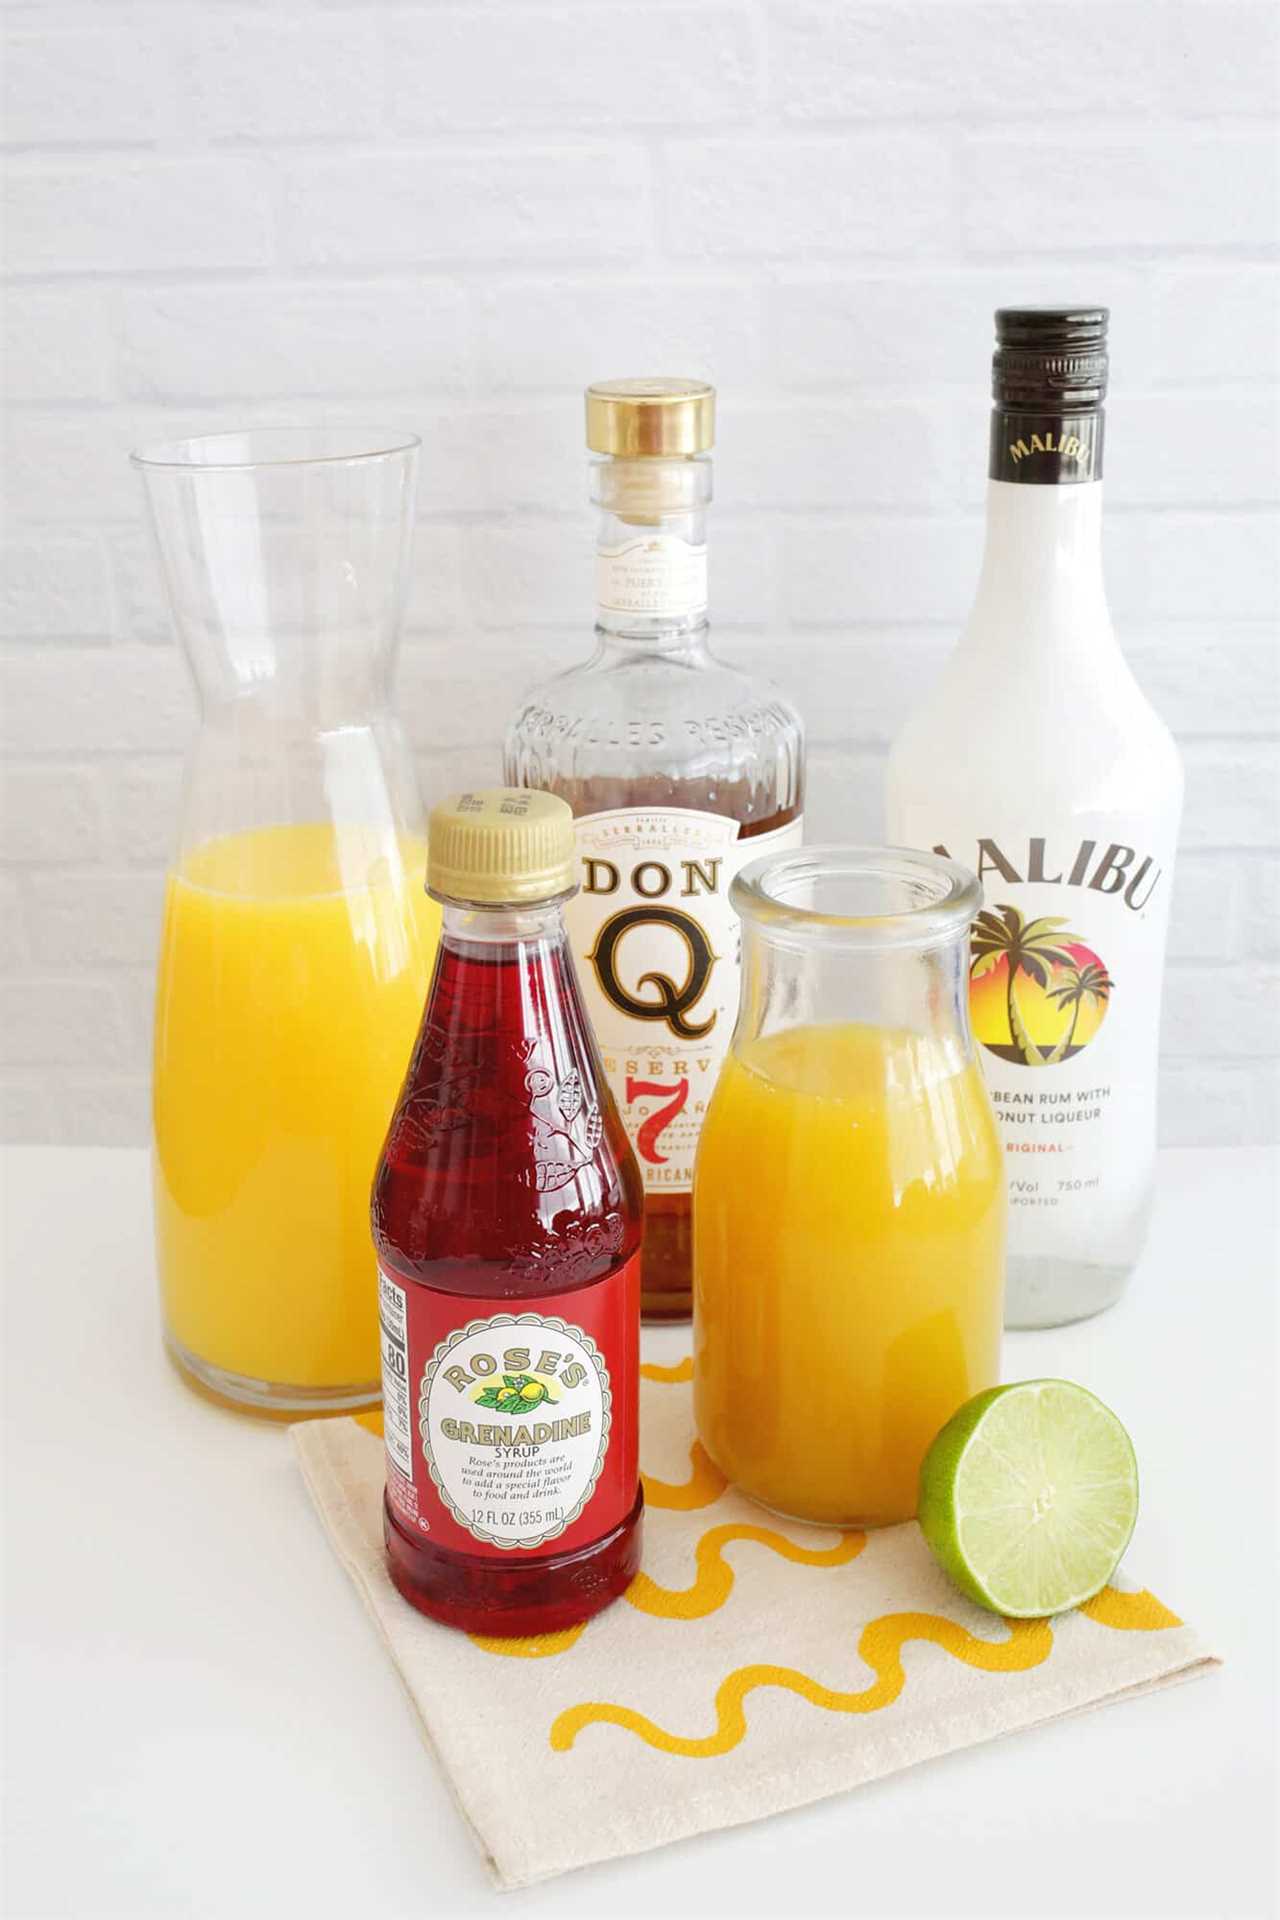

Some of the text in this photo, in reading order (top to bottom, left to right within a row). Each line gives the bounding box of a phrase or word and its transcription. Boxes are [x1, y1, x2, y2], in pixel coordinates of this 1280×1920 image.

[1009, 433, 1090, 464] MALIBU
[582, 856, 723, 899] DON
[584, 904, 721, 1040] Q
[604, 1057, 711, 1075] ESERV
[991, 1087, 1110, 1105] BEAN RUM WITH
[625, 1076, 689, 1164] 7
[1041, 1108, 1101, 1123] LIQUEUR
[1006, 1143, 1063, 1152] RIGINAL
[388, 1343, 406, 1376] 80
[443, 1347, 588, 1393] ROSE'S
[441, 1411, 591, 1447] GRENADINE
[495, 1446, 541, 1459] SYRUP
[461, 1461, 572, 1479] used around the world
[468, 1454, 565, 1470] Rose's products are
[462, 1477, 471, 1486] to
[474, 1478, 493, 1489] add
[505, 1478, 541, 1490] special
[542, 1474, 571, 1488] flavor
[473, 1488, 482, 1498] to
[483, 1489, 507, 1501] food
[509, 1489, 530, 1500] and
[472, 1506, 564, 1526] 12 FL OZ (355 mL)
